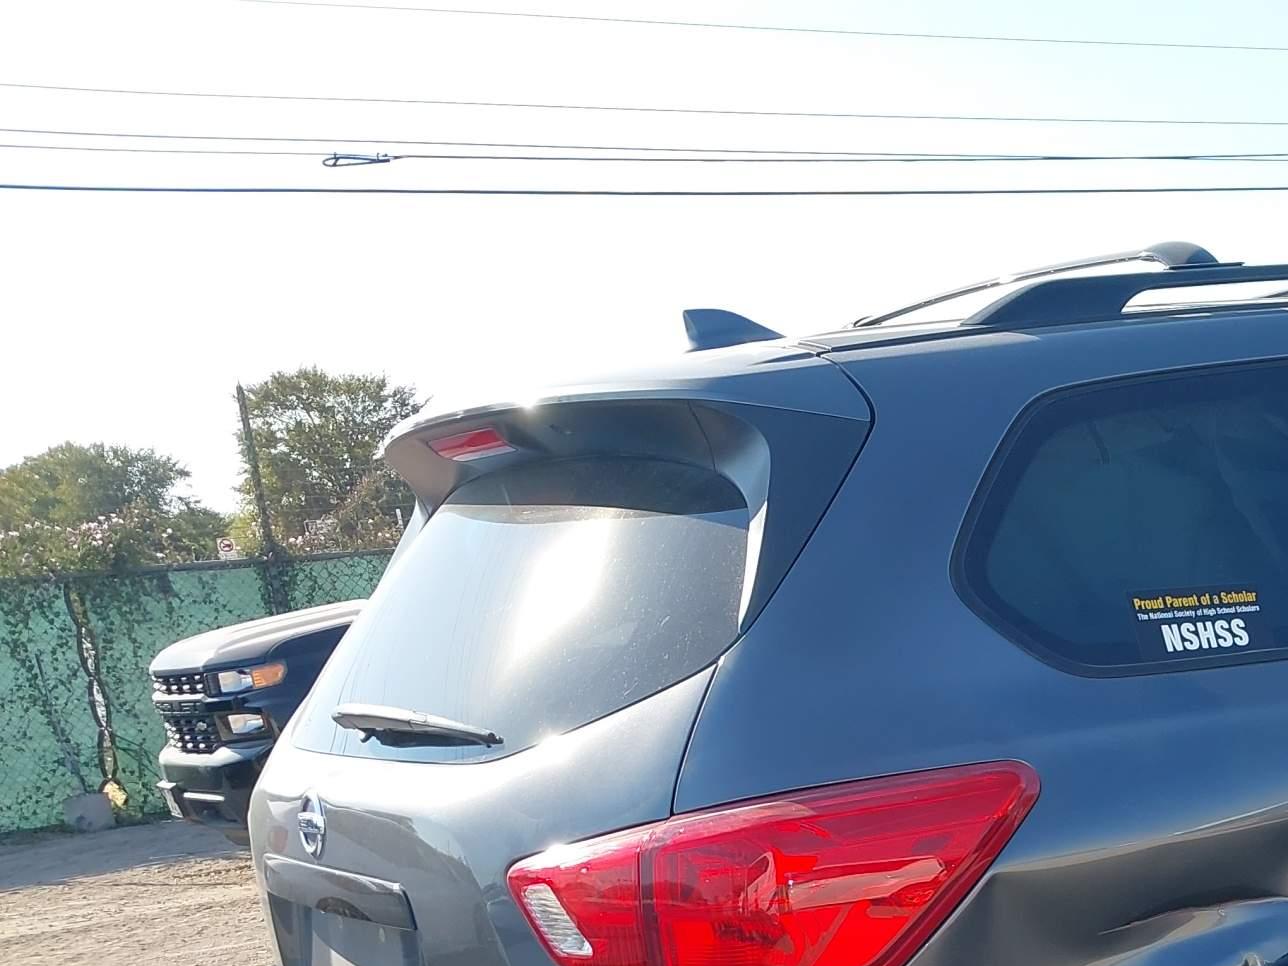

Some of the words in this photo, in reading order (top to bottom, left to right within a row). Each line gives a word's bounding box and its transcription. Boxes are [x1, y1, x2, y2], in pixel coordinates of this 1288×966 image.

[1133, 597, 1164, 610] Proud
[1165, 594, 1199, 608] Parent
[1200, 593, 1211, 606] of
[1212, 594, 1220, 605] a
[1220, 590, 1257, 604] Scholar
[1137, 612, 1149, 621] The
[1149, 611, 1174, 620] National
[1174, 609, 1196, 619] Society
[1196, 608, 1203, 616] of
[1203, 607, 1217, 617] High
[1216, 605, 1236, 615] School
[1236, 604, 1260, 613] Scholars
[1160, 618, 1250, 652] NSHSS
